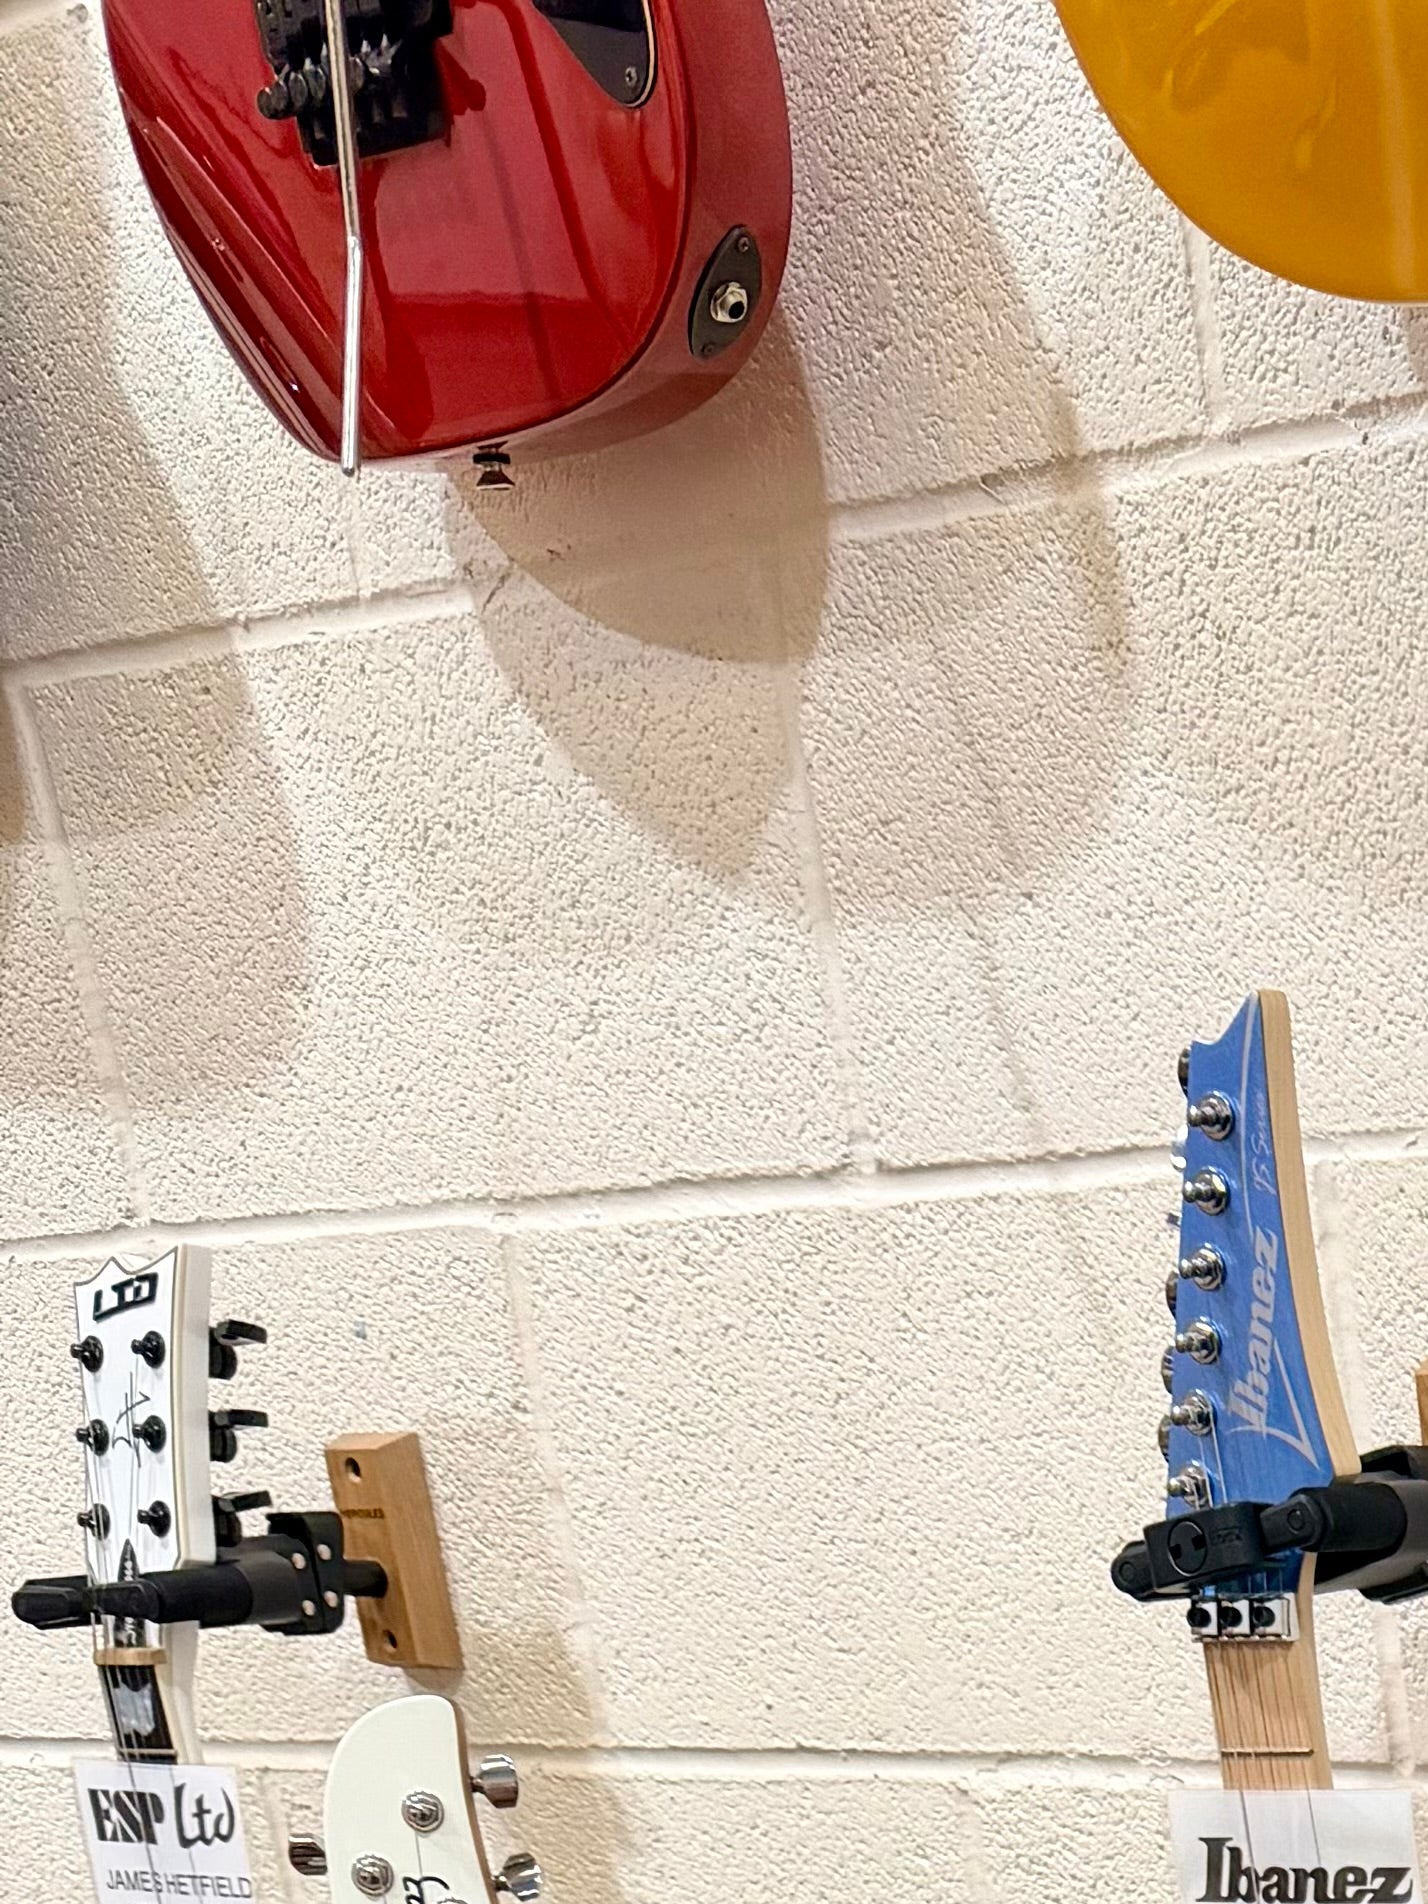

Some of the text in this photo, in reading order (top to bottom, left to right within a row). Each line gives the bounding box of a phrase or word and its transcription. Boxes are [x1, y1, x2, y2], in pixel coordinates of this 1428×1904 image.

[93, 1273, 158, 1321] LTD
[1228, 1226, 1278, 1440] Ibanez
[88, 1788, 164, 1845] ESP
[107, 1870, 252, 1899] JAMES HETFIELD
[1196, 1837, 1414, 1904] Ibanez
